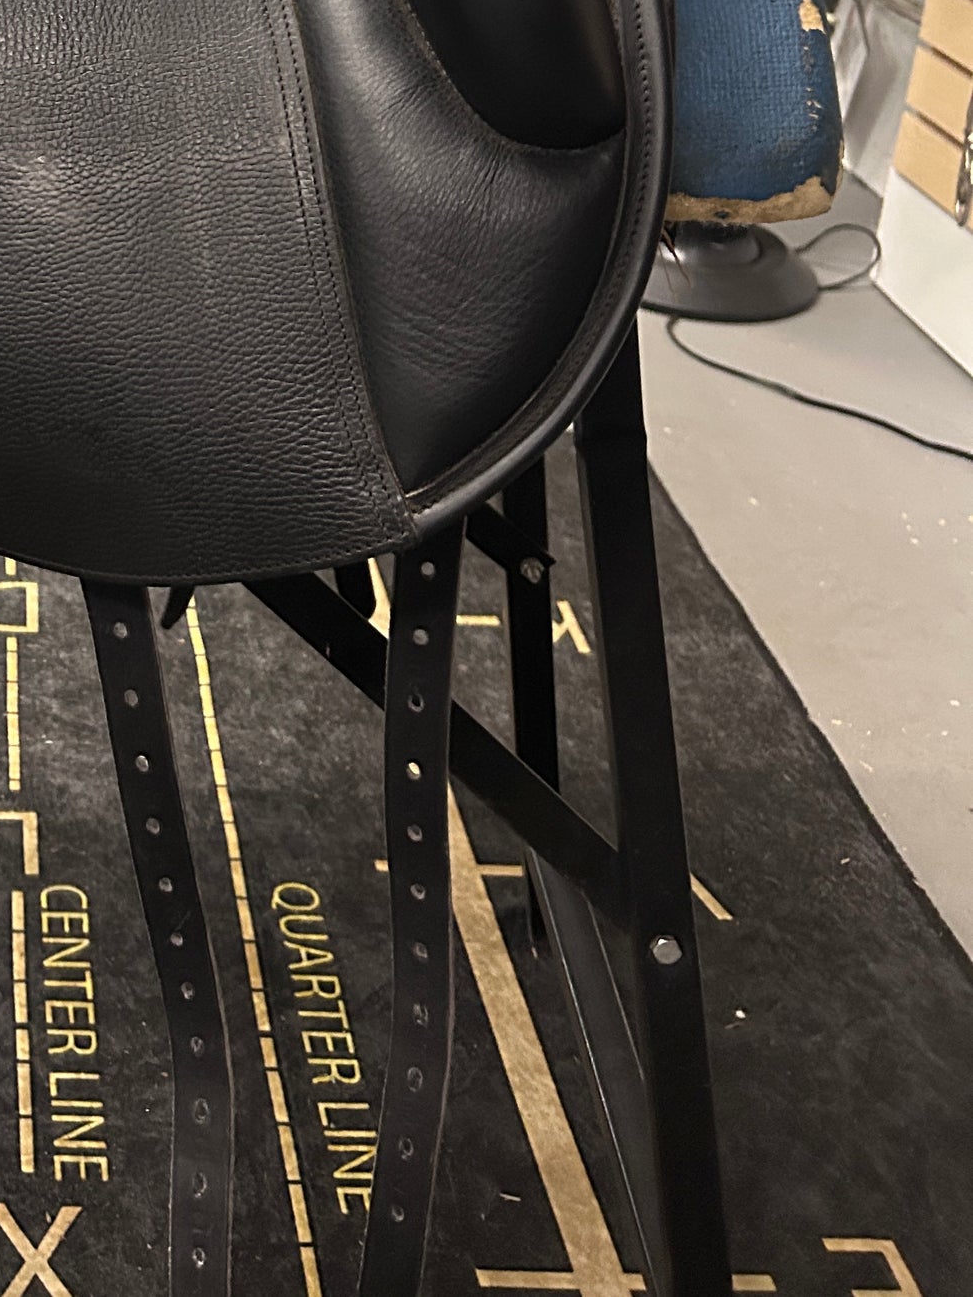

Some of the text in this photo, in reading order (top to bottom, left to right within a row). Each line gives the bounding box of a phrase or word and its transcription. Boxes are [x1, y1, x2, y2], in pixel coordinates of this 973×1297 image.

[40, 884, 109, 1182] CENTER LINE
[271, 882, 361, 1085] QUARTER
